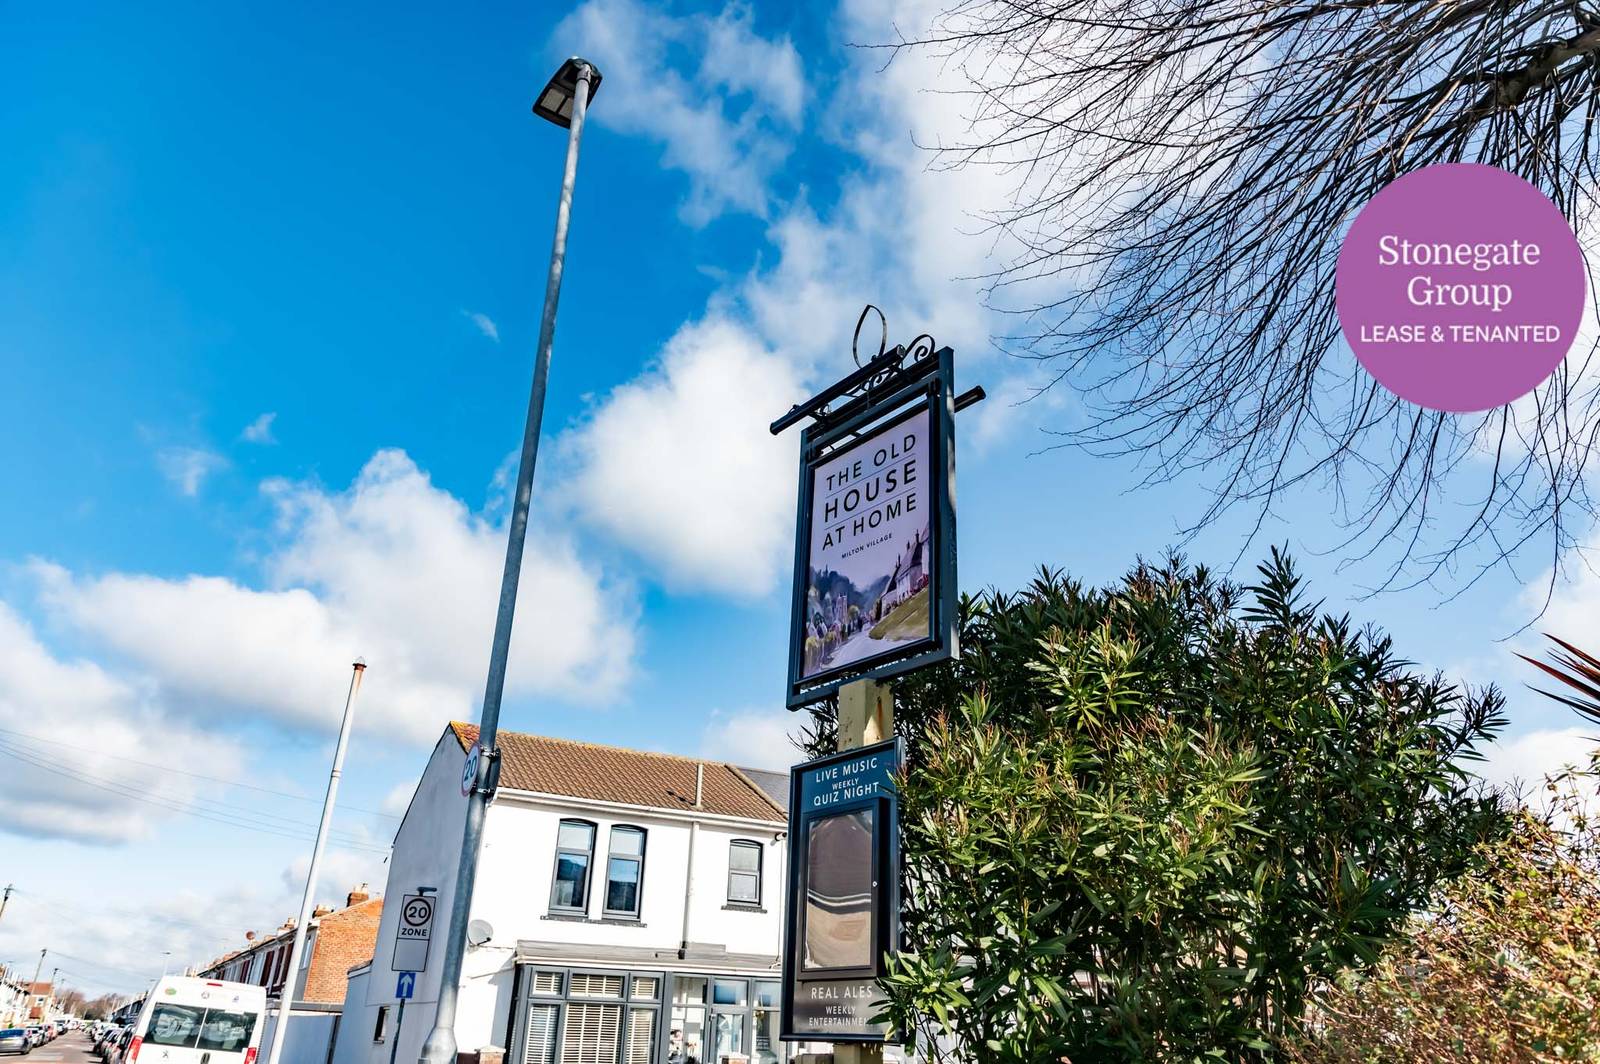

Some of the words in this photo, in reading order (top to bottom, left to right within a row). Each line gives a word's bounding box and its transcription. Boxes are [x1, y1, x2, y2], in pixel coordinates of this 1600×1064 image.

[826, 460, 862, 491] THE
[873, 434, 916, 467] OLD
[824, 459, 917, 523] HOUSE
[822, 525, 846, 551] AT
[853, 492, 917, 537] HOME
[841, 544, 865, 559] MILTON
[866, 532, 893, 548] VILLAGE
[464, 755, 477, 781] 20
[815, 767, 838, 783] LIVE
[842, 757, 878, 776] MUSIC
[813, 791, 840, 806] QUIZ
[843, 782, 880, 800] NIGHT
[831, 777, 860, 791] WEEKLY
[408, 906, 428, 919] 20
[401, 927, 428, 937] ZONE
[811, 987, 839, 1000] REAL
[843, 985, 873, 999] ALES
[808, 1016, 873, 1027] ENTERTAINMEN
[825, 1005, 857, 1015] WEEKLY
